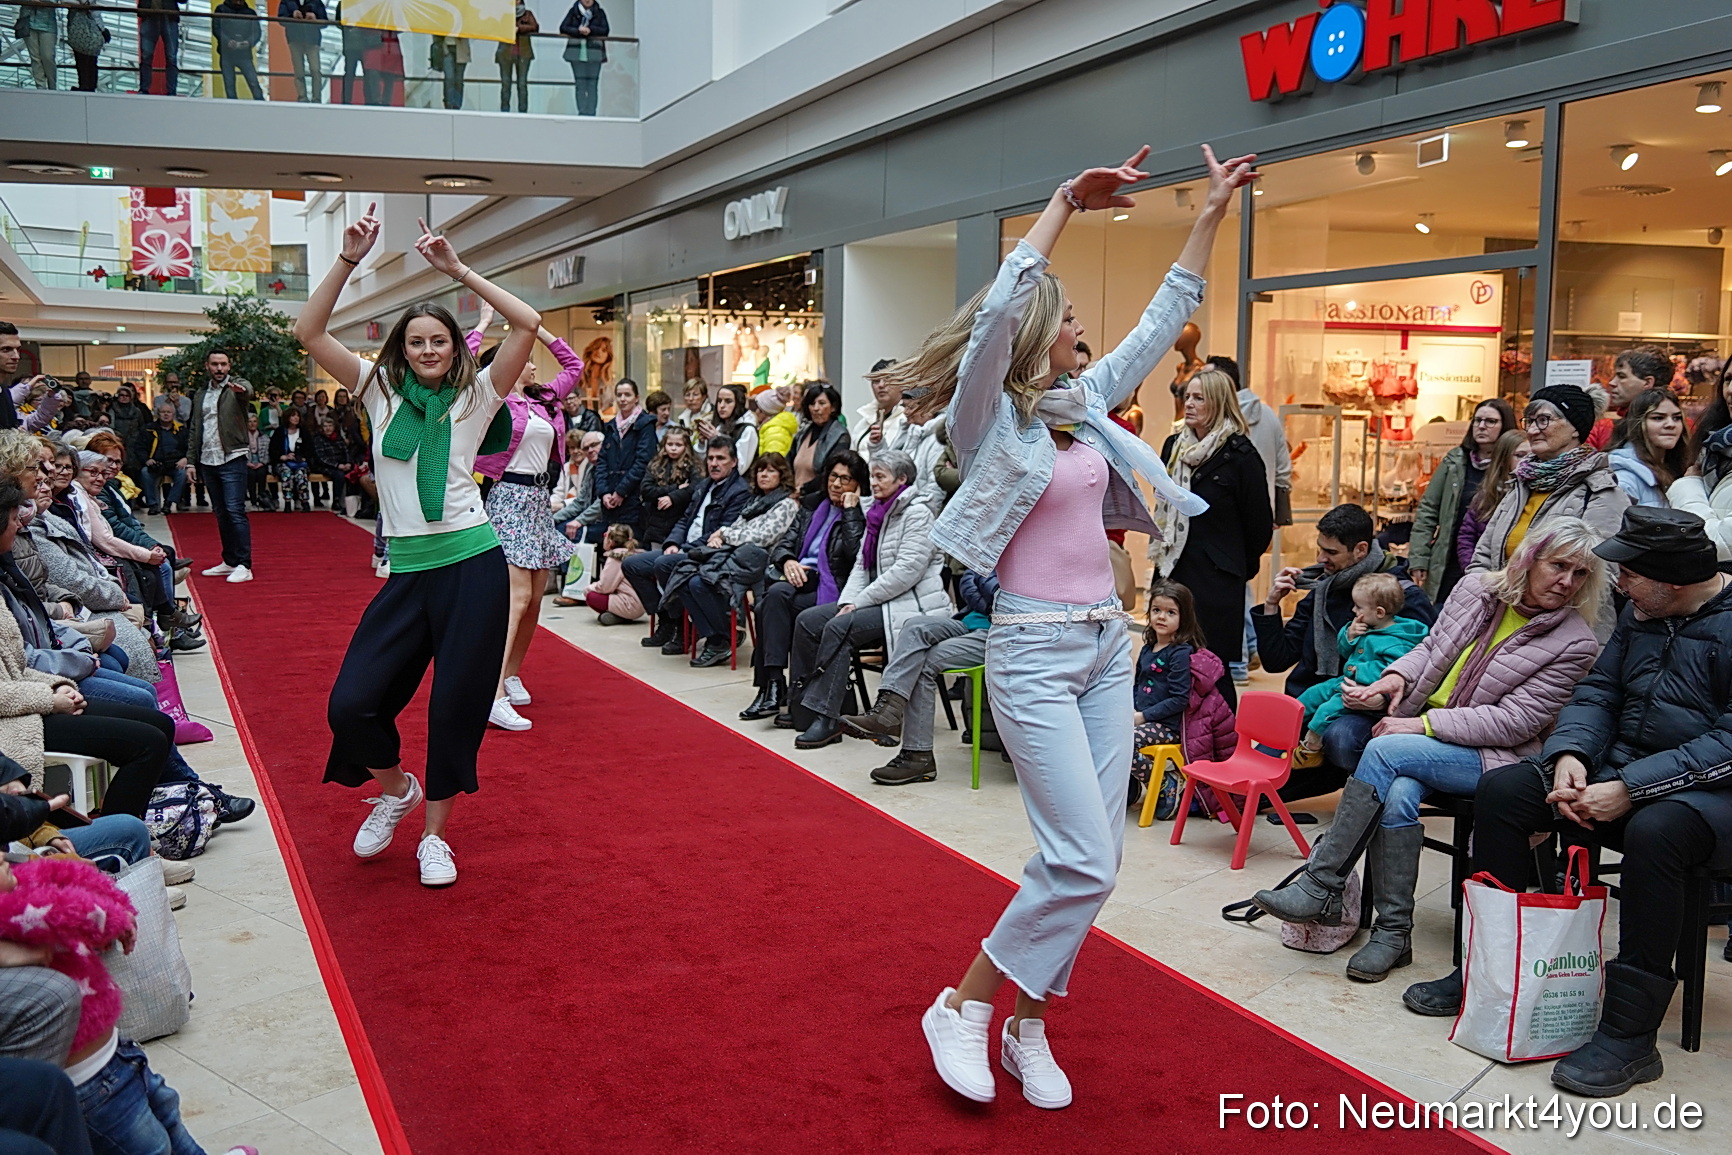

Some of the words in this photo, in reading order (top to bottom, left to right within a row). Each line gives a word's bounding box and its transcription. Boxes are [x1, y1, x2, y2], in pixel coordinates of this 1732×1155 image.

[724, 187, 788, 241] ONLY
[547, 256, 584, 290] ONLY
[1419, 371, 1482, 384] Passionata
